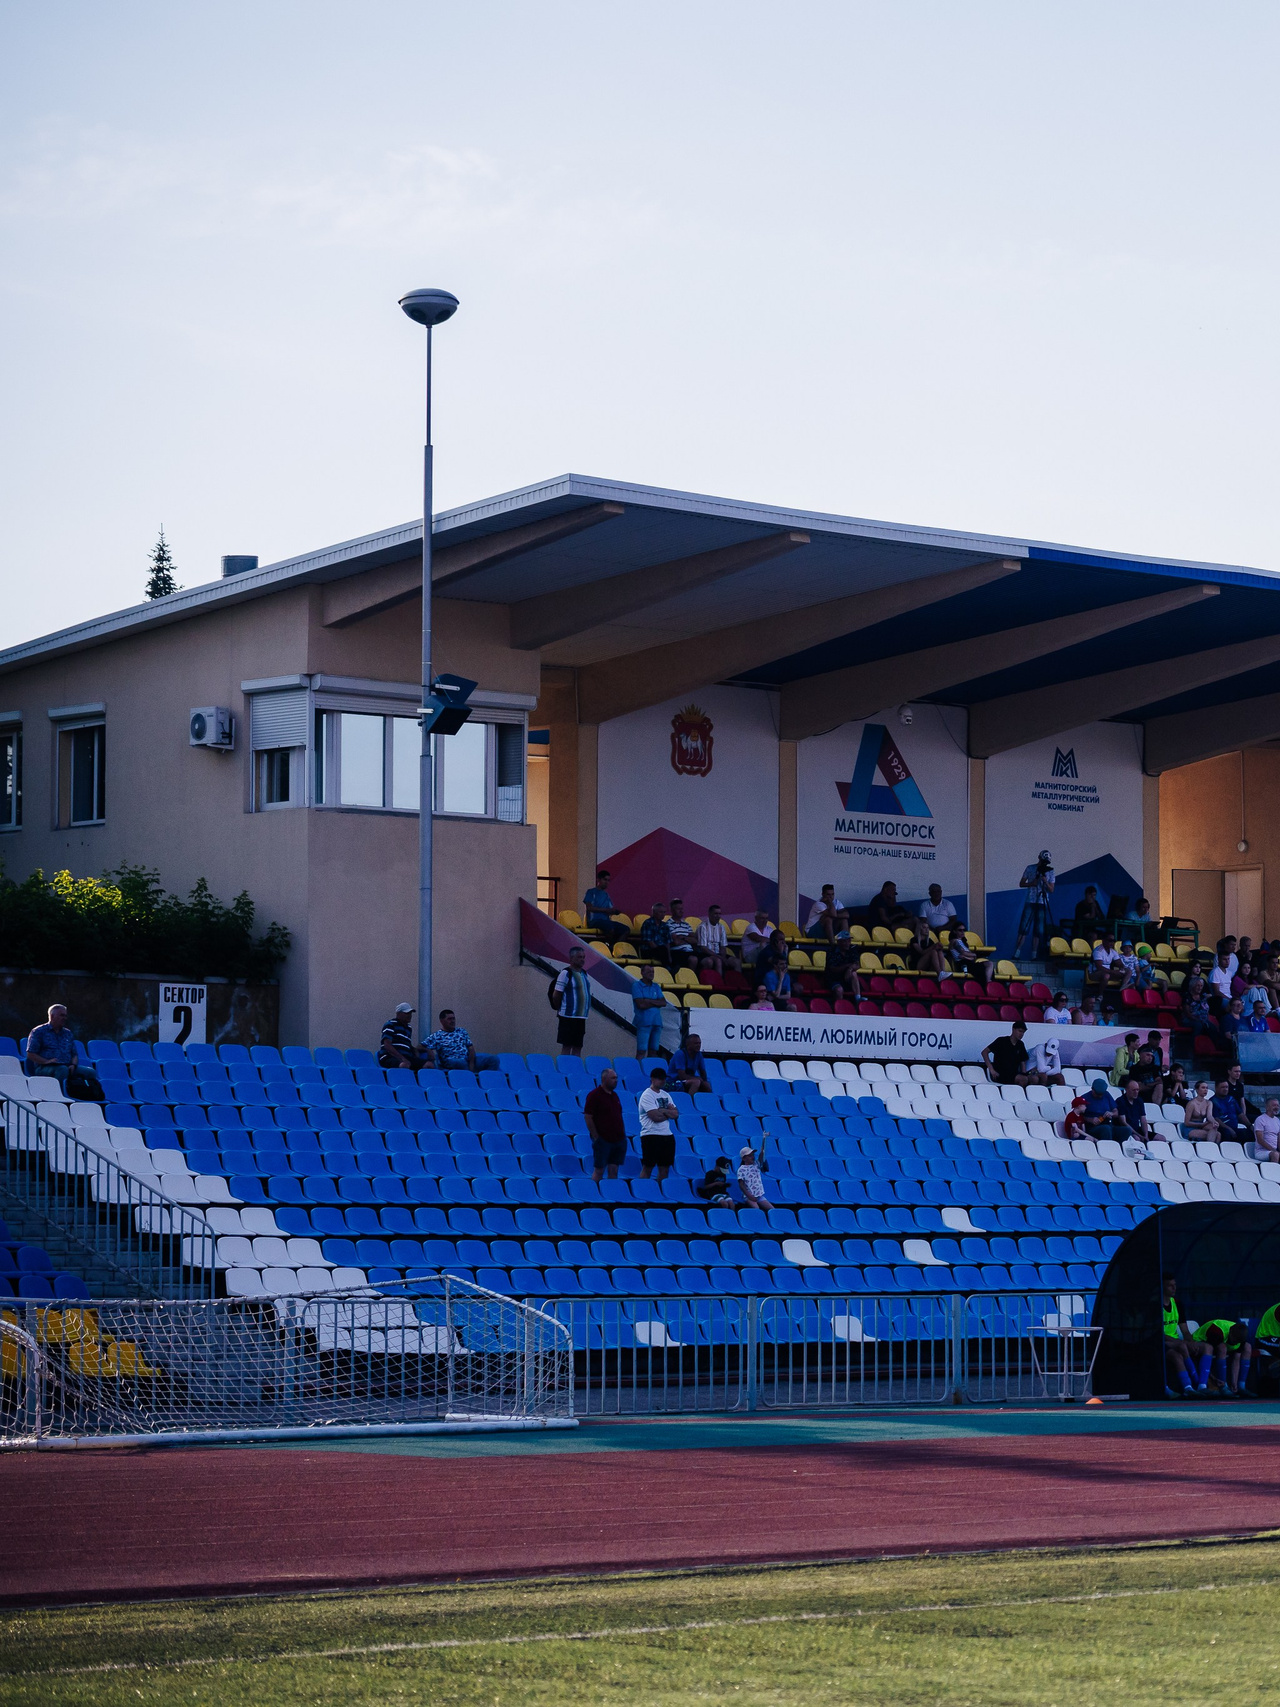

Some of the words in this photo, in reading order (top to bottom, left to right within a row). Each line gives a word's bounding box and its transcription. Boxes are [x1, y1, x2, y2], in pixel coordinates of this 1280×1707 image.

[887, 751, 907, 780] 1929
[1034, 781, 1097, 794] МАГНИТОГОРСКИЙ
[1031, 791, 1100, 804] МЕТАЛЛУРГИЧЕСКИЙ
[1047, 802, 1085, 813] КОМБИНАТ
[834, 817, 935, 840] МАГНИТОГОРСК
[834, 845, 852, 854] НАШ
[903, 850, 936, 861] БУДУЩЕЕ
[164, 986, 204, 1003] СЕКТОР
[173, 1006, 192, 1046] 2
[724, 1023, 736, 1040] С
[740, 1024, 816, 1045] ЮБИЛЕЕМ,
[820, 1027, 897, 1046] ЛЮБИМЫЙ
[901, 1031, 953, 1050] ГОРОД!
